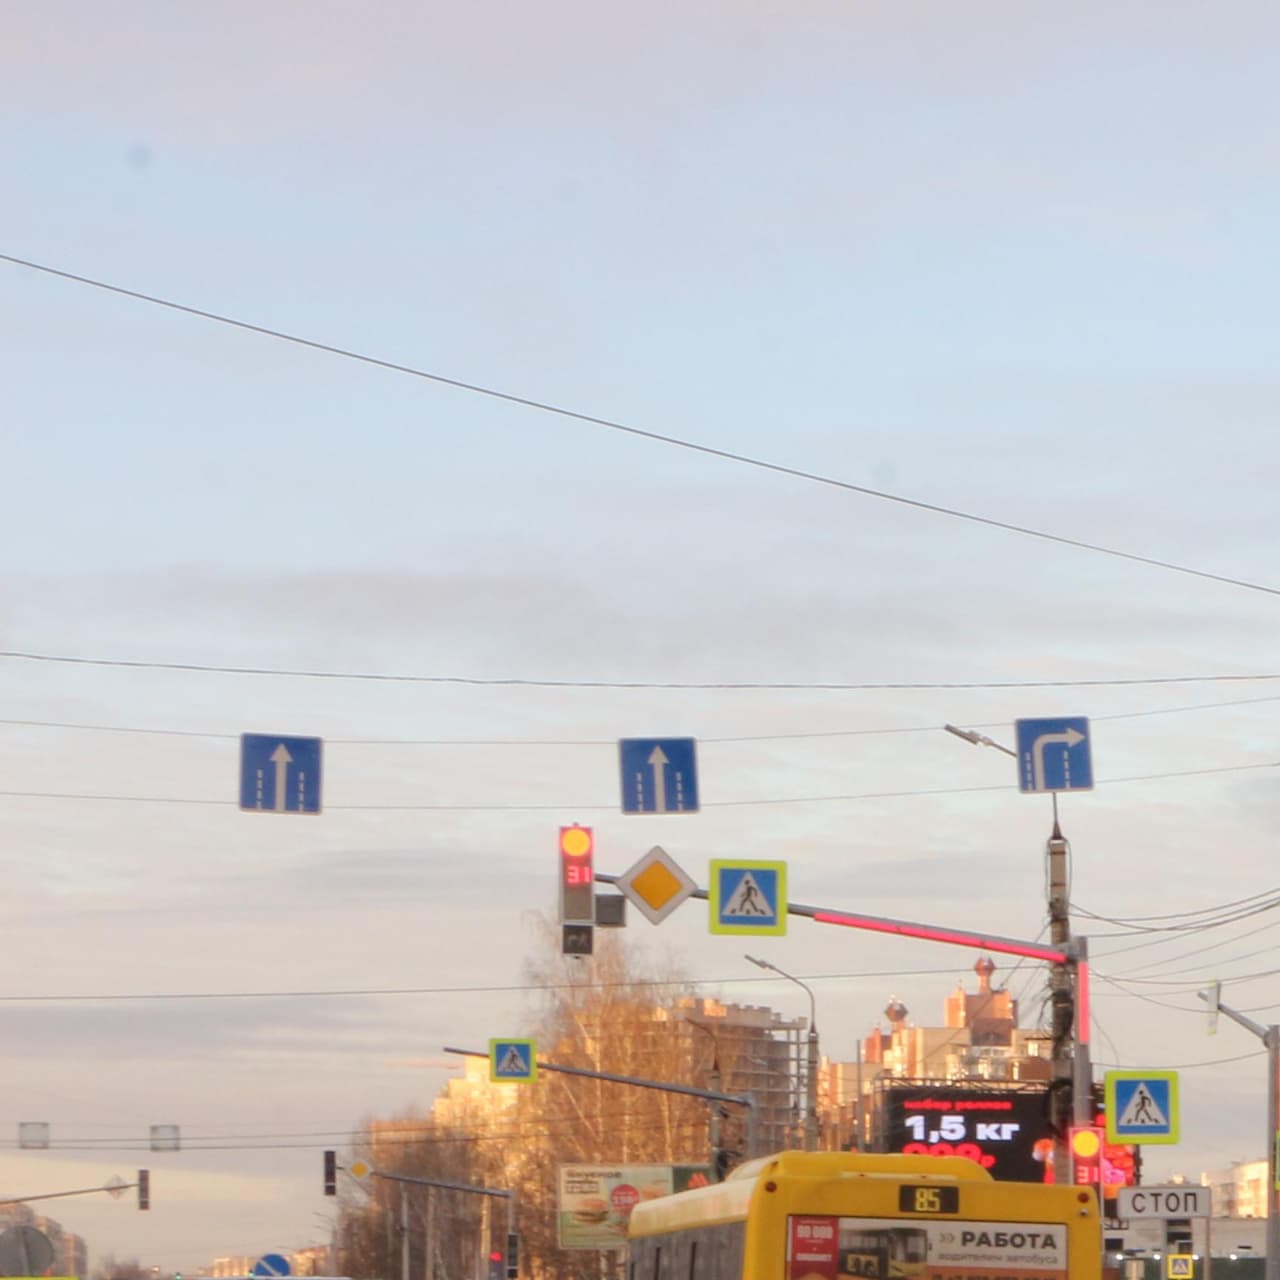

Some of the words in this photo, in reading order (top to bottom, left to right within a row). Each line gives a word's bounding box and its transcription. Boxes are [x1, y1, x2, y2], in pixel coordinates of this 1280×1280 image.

[567, 866, 591, 884] 31
[904, 1115, 967, 1143] 1,5
[976, 1123, 1020, 1141] кг
[915, 1187, 941, 1212] 85
[1131, 1191, 1198, 1213] СТОП
[961, 1231, 1057, 1250] РАБОТА
